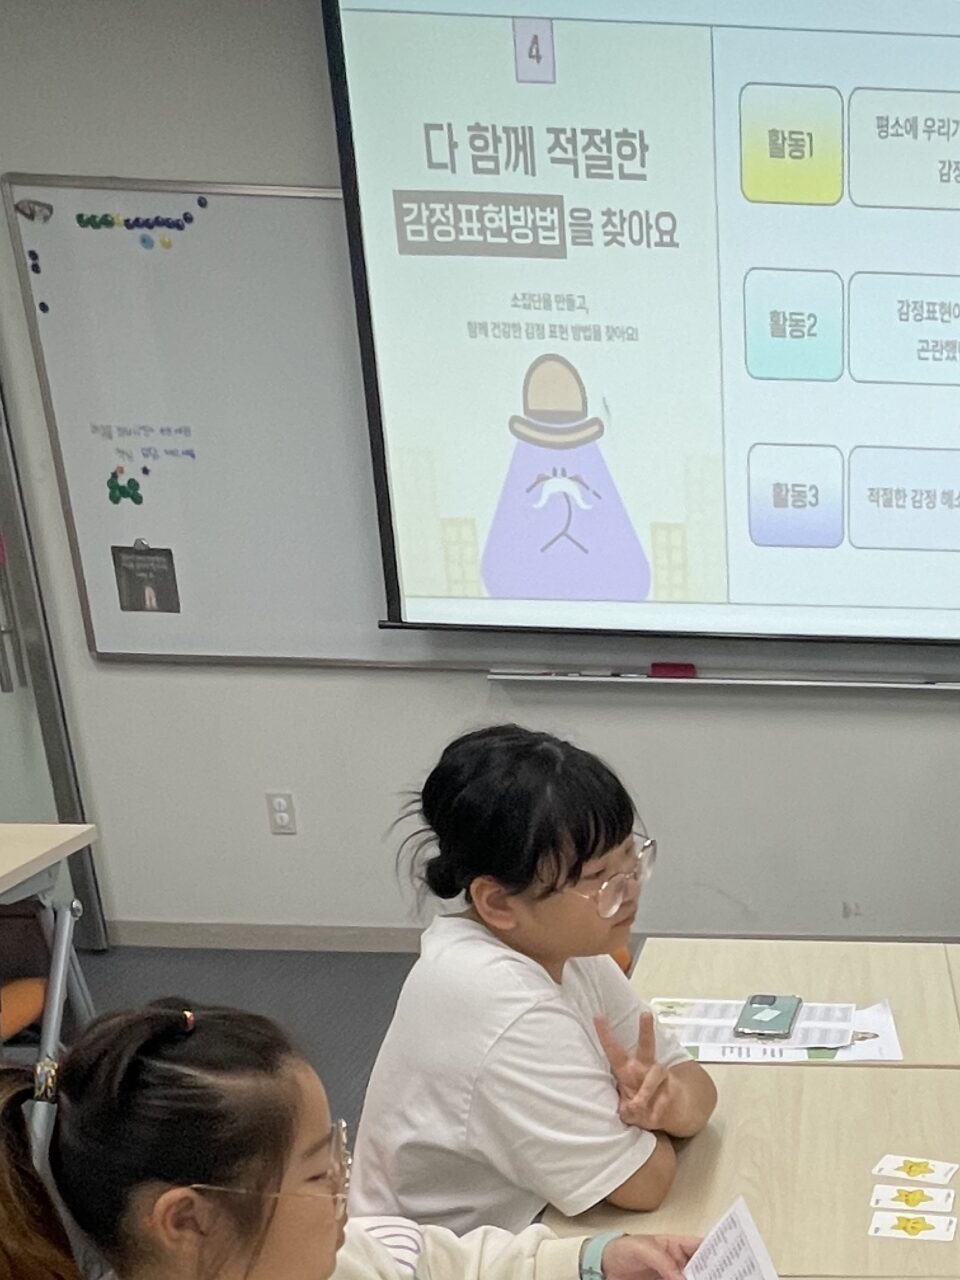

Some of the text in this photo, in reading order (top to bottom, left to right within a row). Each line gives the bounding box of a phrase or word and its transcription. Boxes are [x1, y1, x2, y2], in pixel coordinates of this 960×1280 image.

[527, 34, 543, 64] 4
[875, 115, 919, 140] 평소에
[423, 122, 650, 182] 다 함께 적절한
[768, 128, 814, 160] 활동1
[402, 201, 680, 249] 감정표현방법을 찾아요
[769, 309, 818, 340] 활동2
[772, 481, 819, 509] 활동3
[867, 487, 907, 509] 적절한
[910, 488, 937, 510] 감정
